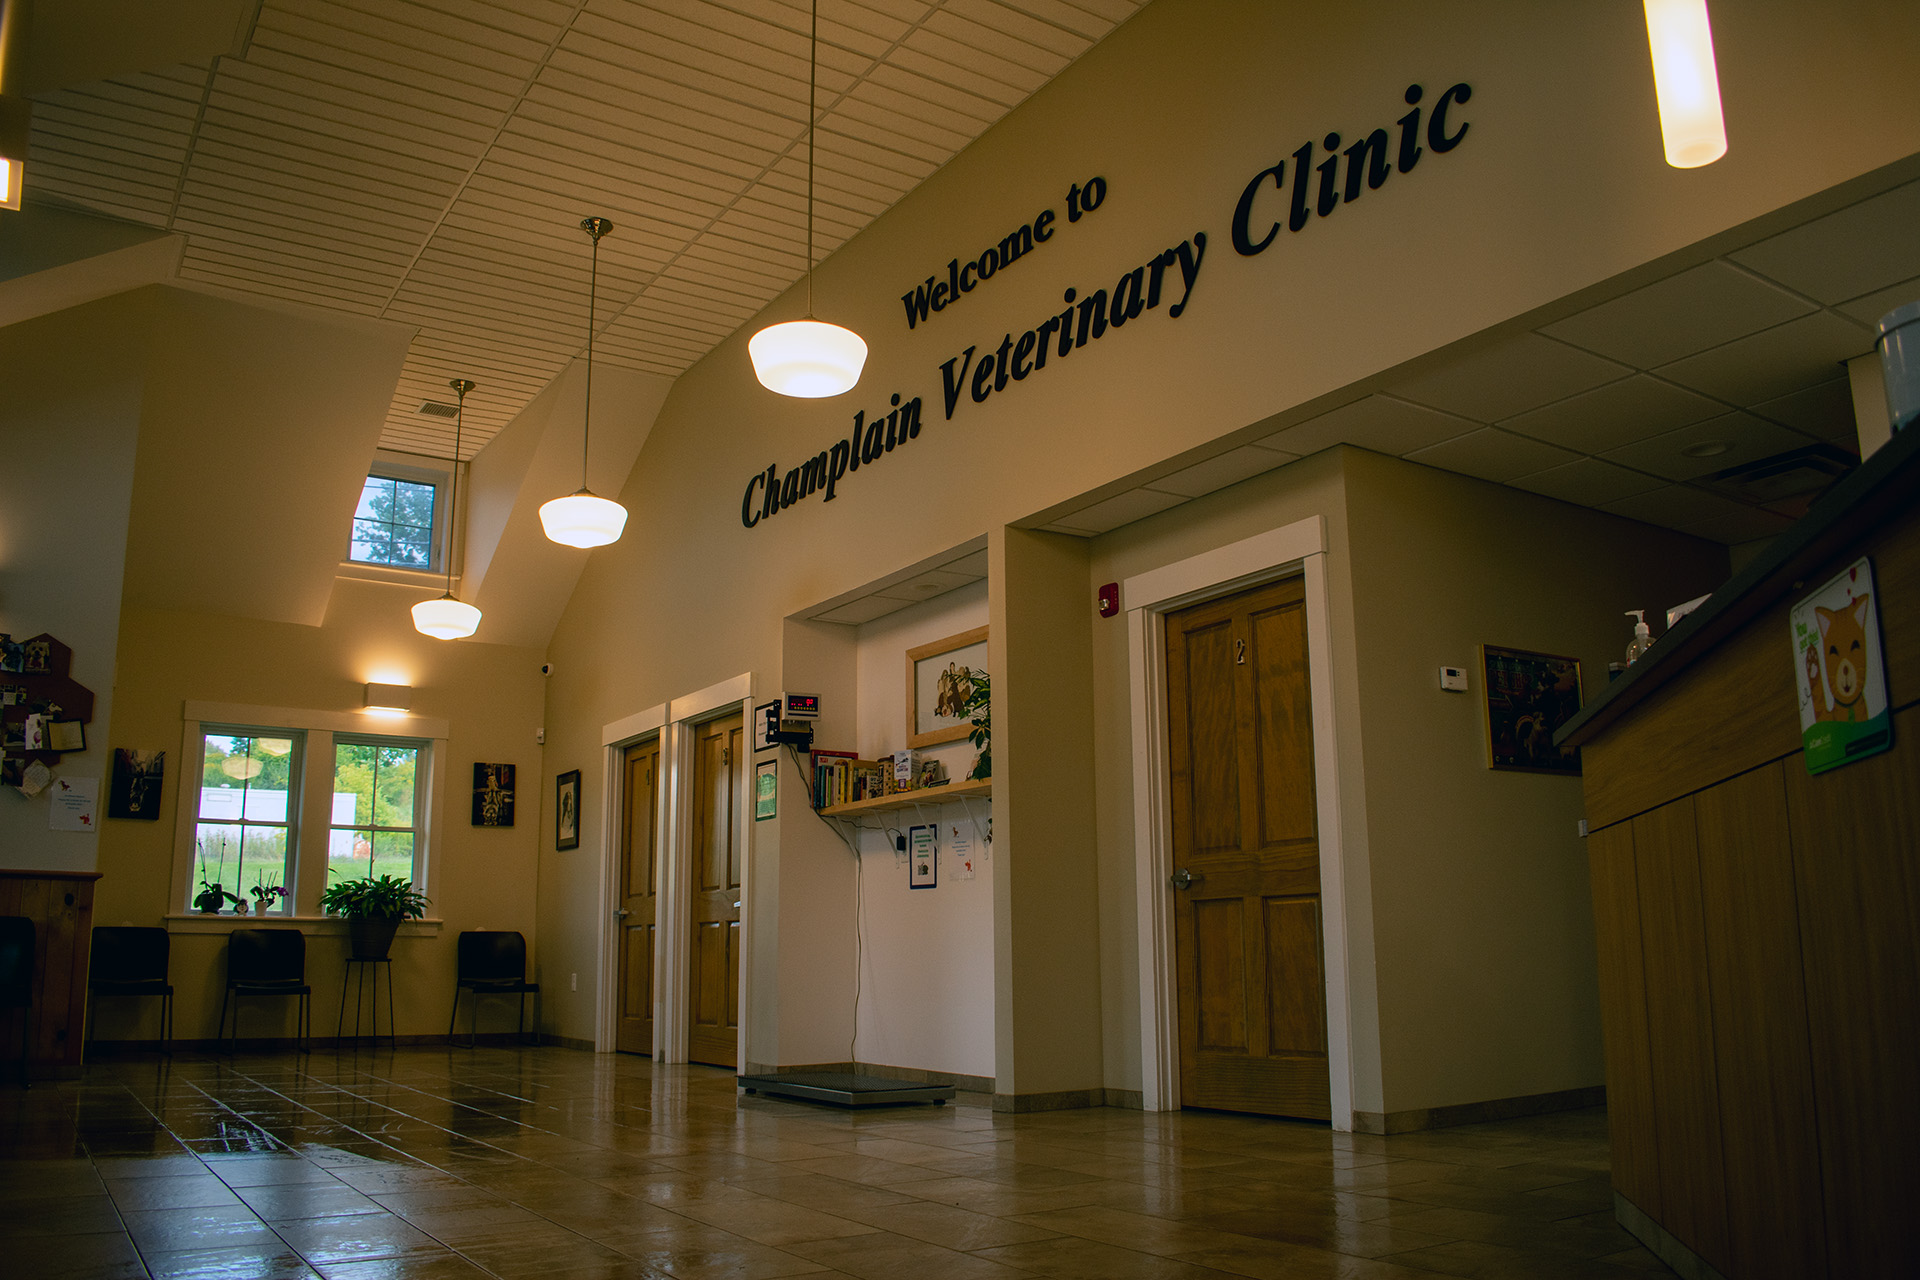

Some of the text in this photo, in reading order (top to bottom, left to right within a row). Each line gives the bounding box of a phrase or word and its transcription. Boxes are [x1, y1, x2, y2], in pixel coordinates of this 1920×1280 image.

[741, 82, 1473, 528] Champlain Veterinary Clinic
[901, 175, 1107, 330] Welcome to
[1235, 638, 1246, 666] 2
